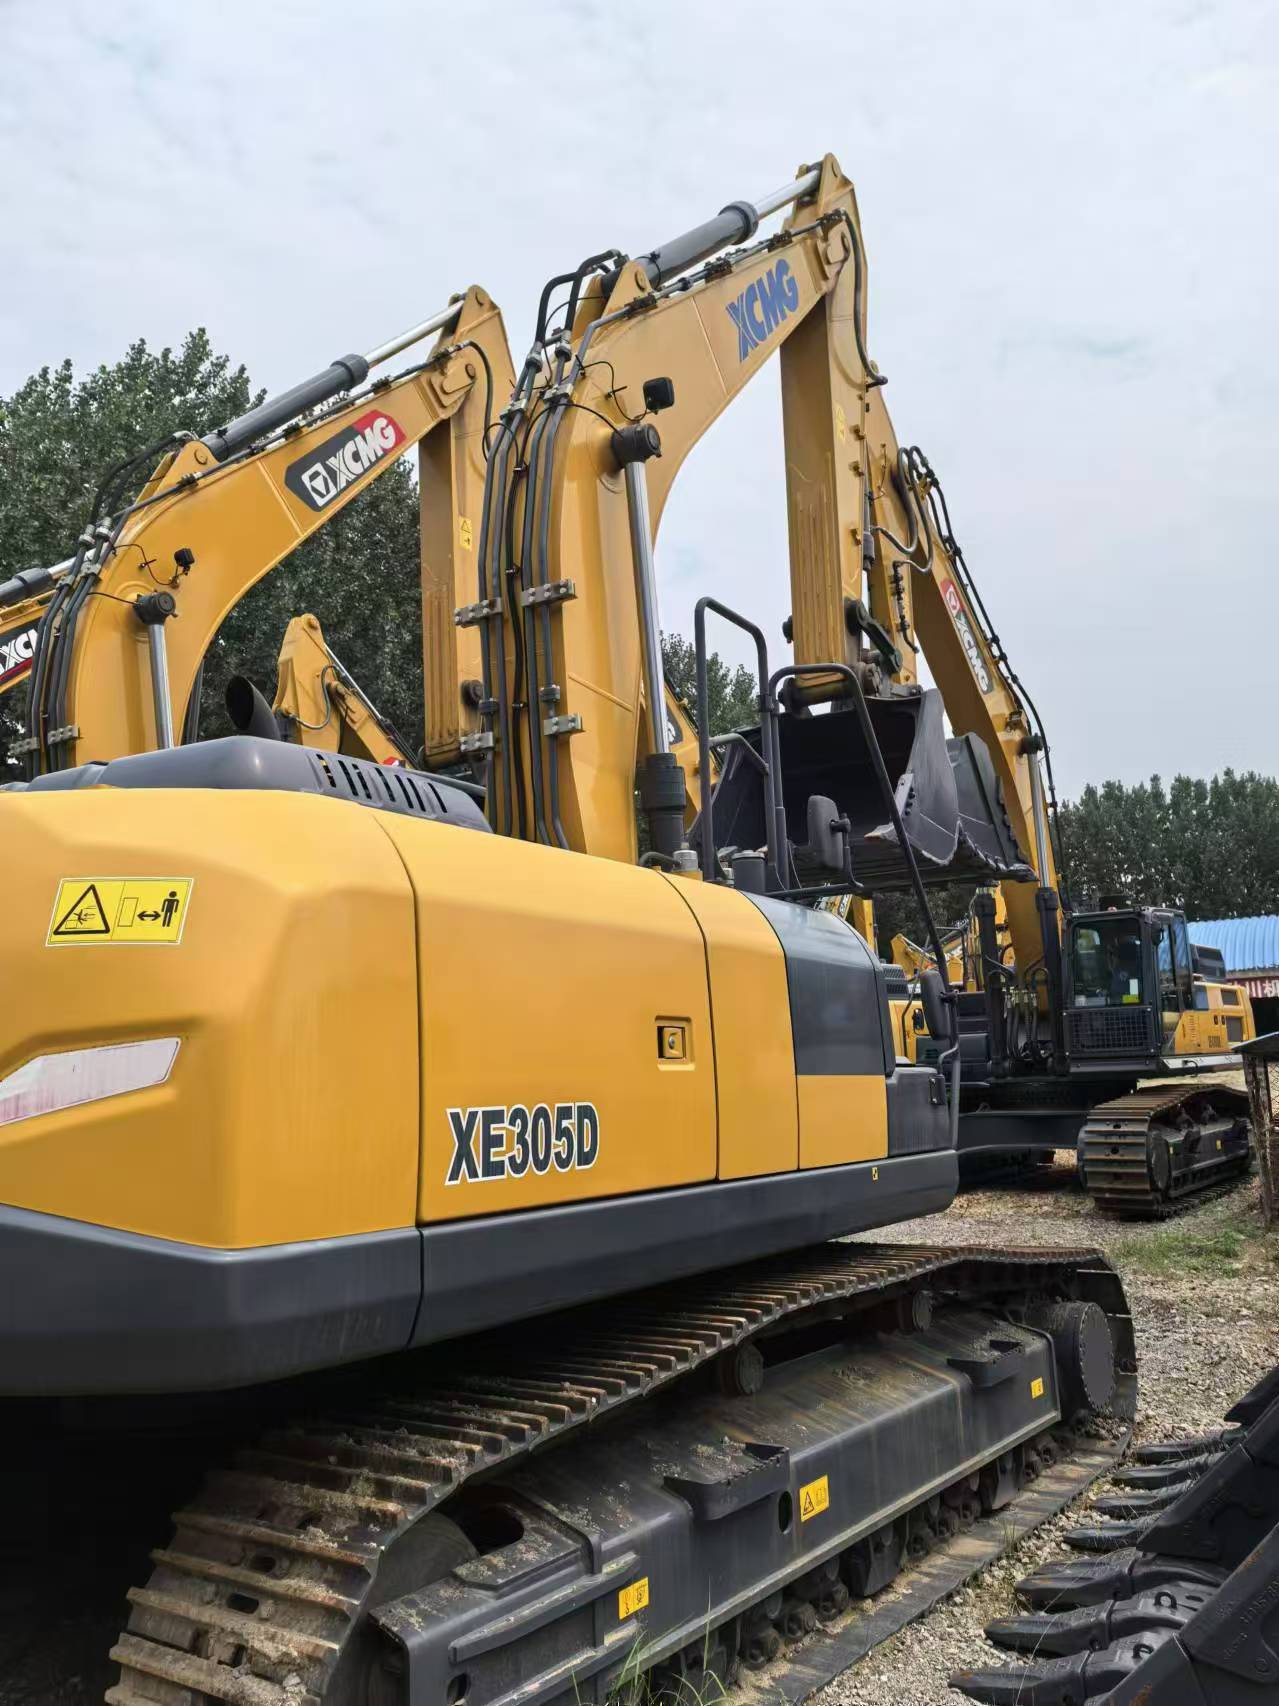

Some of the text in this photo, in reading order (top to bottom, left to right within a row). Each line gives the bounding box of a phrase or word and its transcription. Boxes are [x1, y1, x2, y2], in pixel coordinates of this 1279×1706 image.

[726, 258, 798, 364] XCMG
[325, 417, 396, 492] XCMG
[0, 628, 38, 672] XC
[445, 1101, 600, 1186] XE305D
